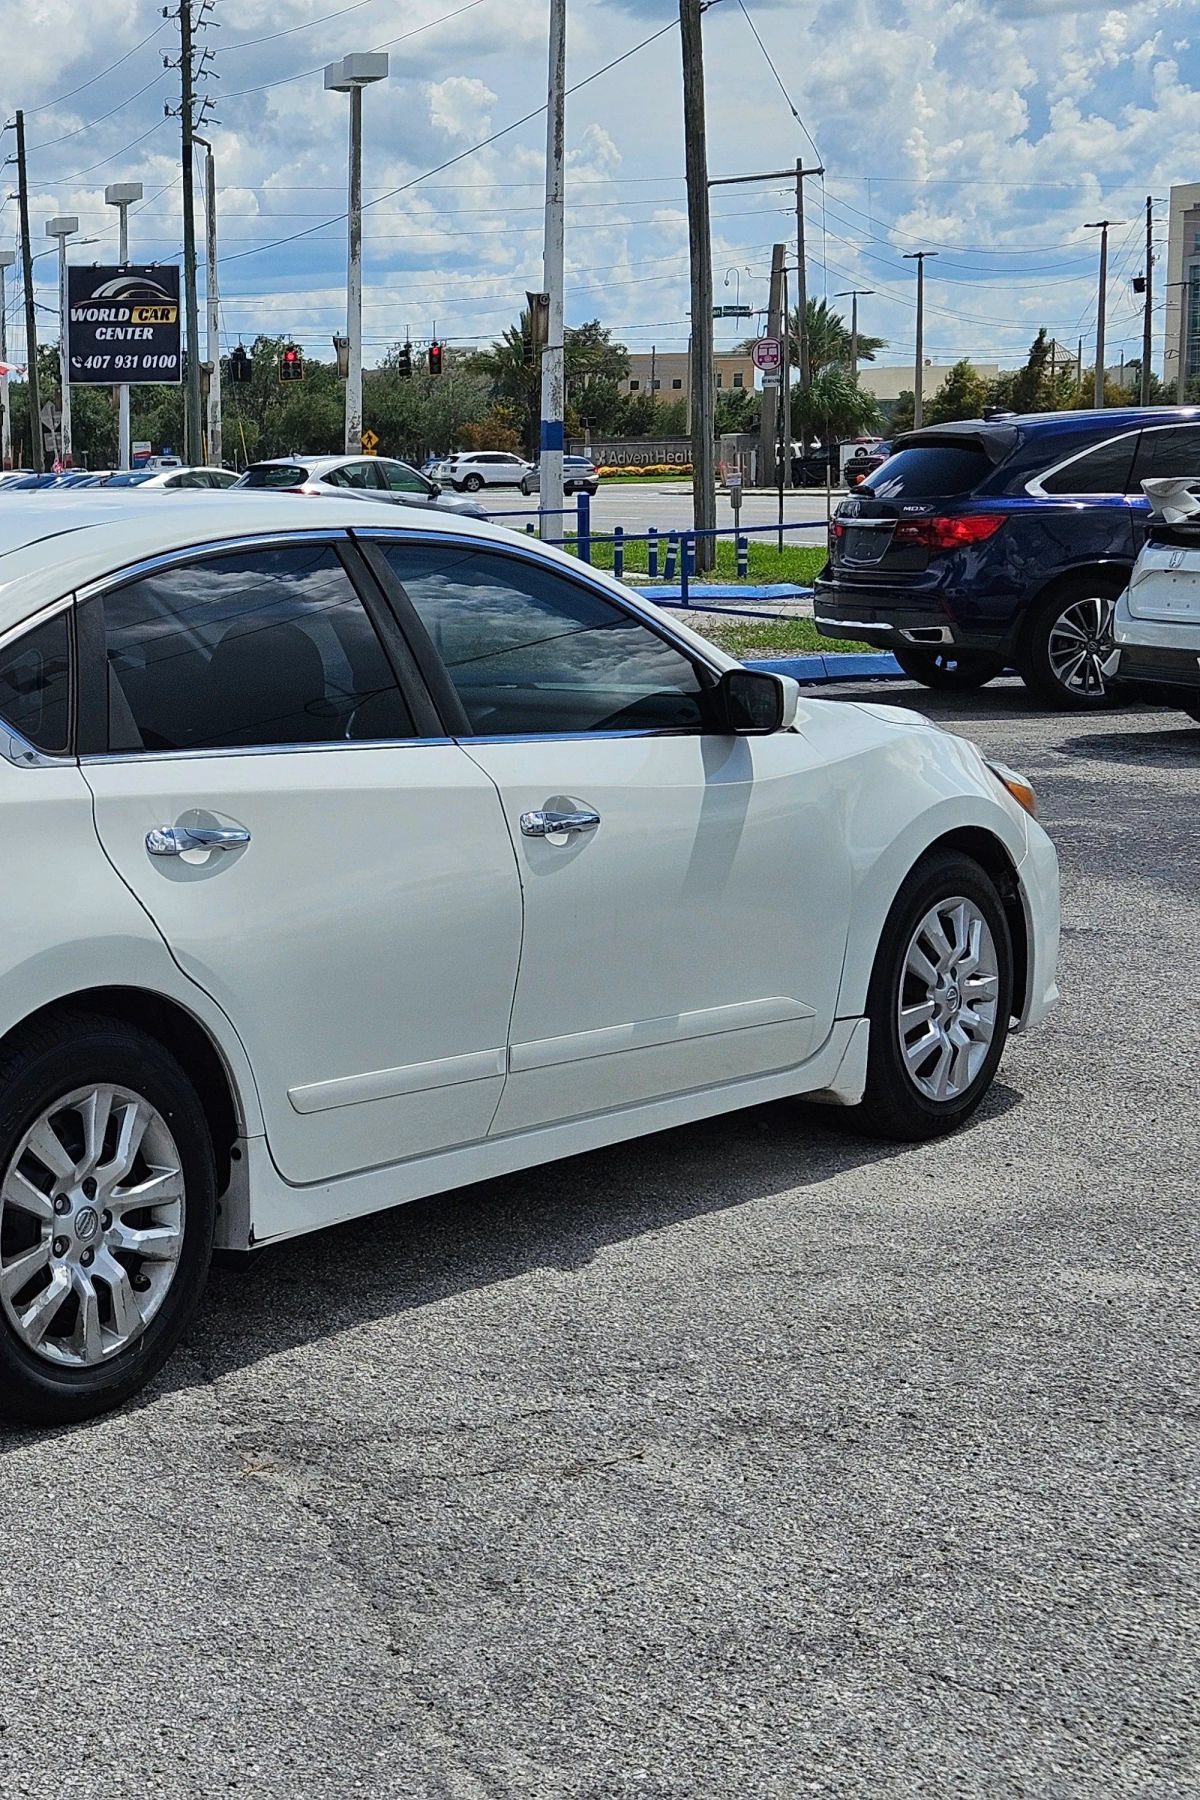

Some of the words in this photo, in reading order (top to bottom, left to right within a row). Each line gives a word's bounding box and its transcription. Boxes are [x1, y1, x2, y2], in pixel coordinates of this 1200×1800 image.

[70, 308, 130, 321] WORLD
[138, 308, 170, 321] CAR
[95, 327, 154, 340] CENTER
[84, 355, 112, 369] 407
[114, 355, 138, 369] 931
[142, 354, 177, 369] 0100
[608, 449, 693, 465] AdventHealt
